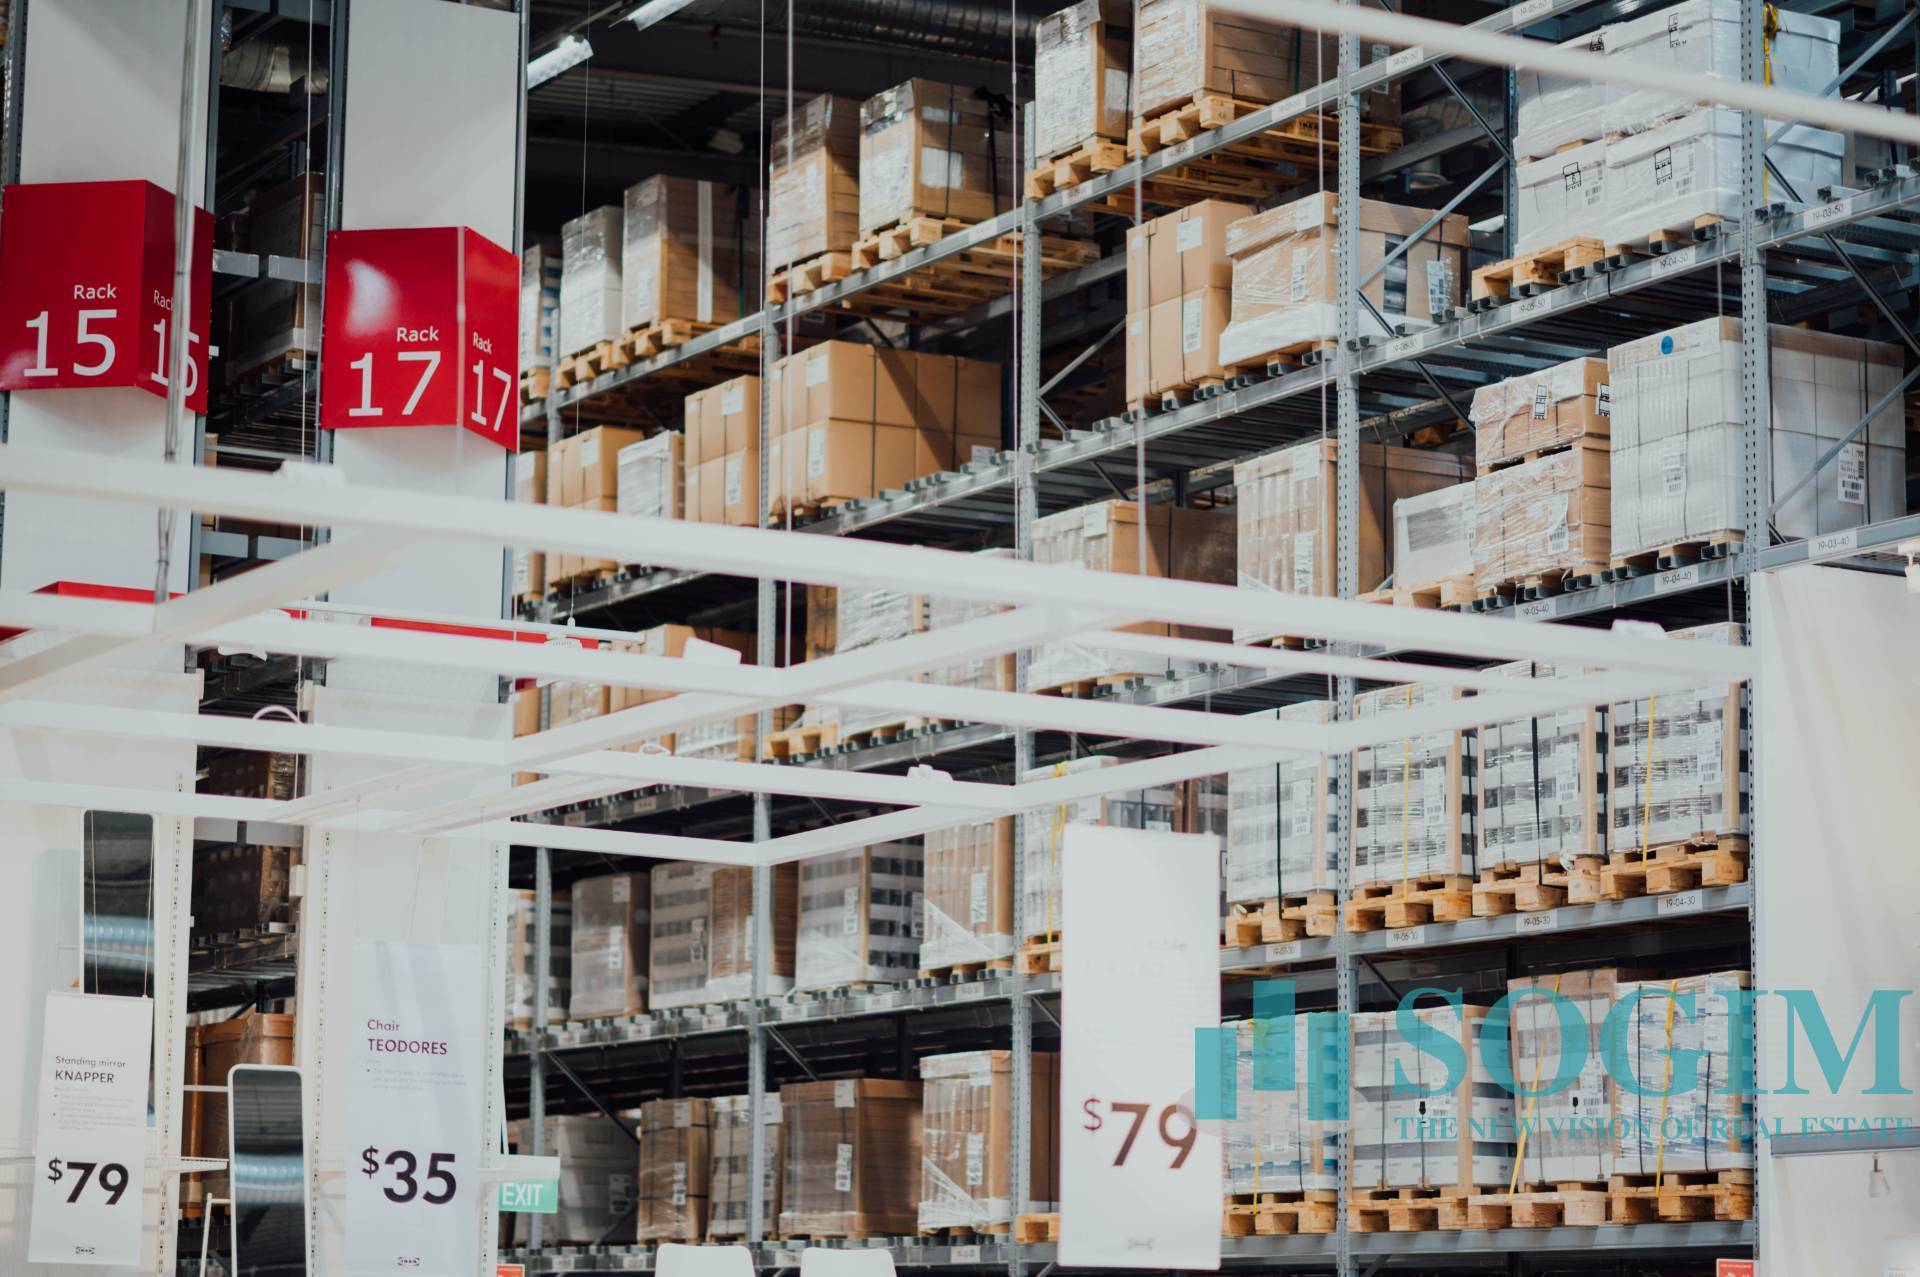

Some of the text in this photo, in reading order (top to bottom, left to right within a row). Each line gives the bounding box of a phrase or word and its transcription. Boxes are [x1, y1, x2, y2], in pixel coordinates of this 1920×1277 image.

[73, 283, 117, 300] Rack
[23, 309, 118, 377] 15
[396, 326, 439, 343] Rack
[472, 331, 493, 355] Rack
[348, 350, 441, 417] 17
[471, 359, 512, 432] 17
[1666, 896, 1696, 909] 19-04-30
[367, 1019, 401, 1032] Chair
[367, 1038, 448, 1056] TEODORES
[55, 1055, 127, 1069] Standing mirror
[55, 1069, 115, 1084] KNAPPER
[1083, 1095, 1197, 1170] $79
[47, 1156, 129, 1206] $79
[361, 1144, 457, 1205] $35
[502, 1181, 544, 1207] EXIT
